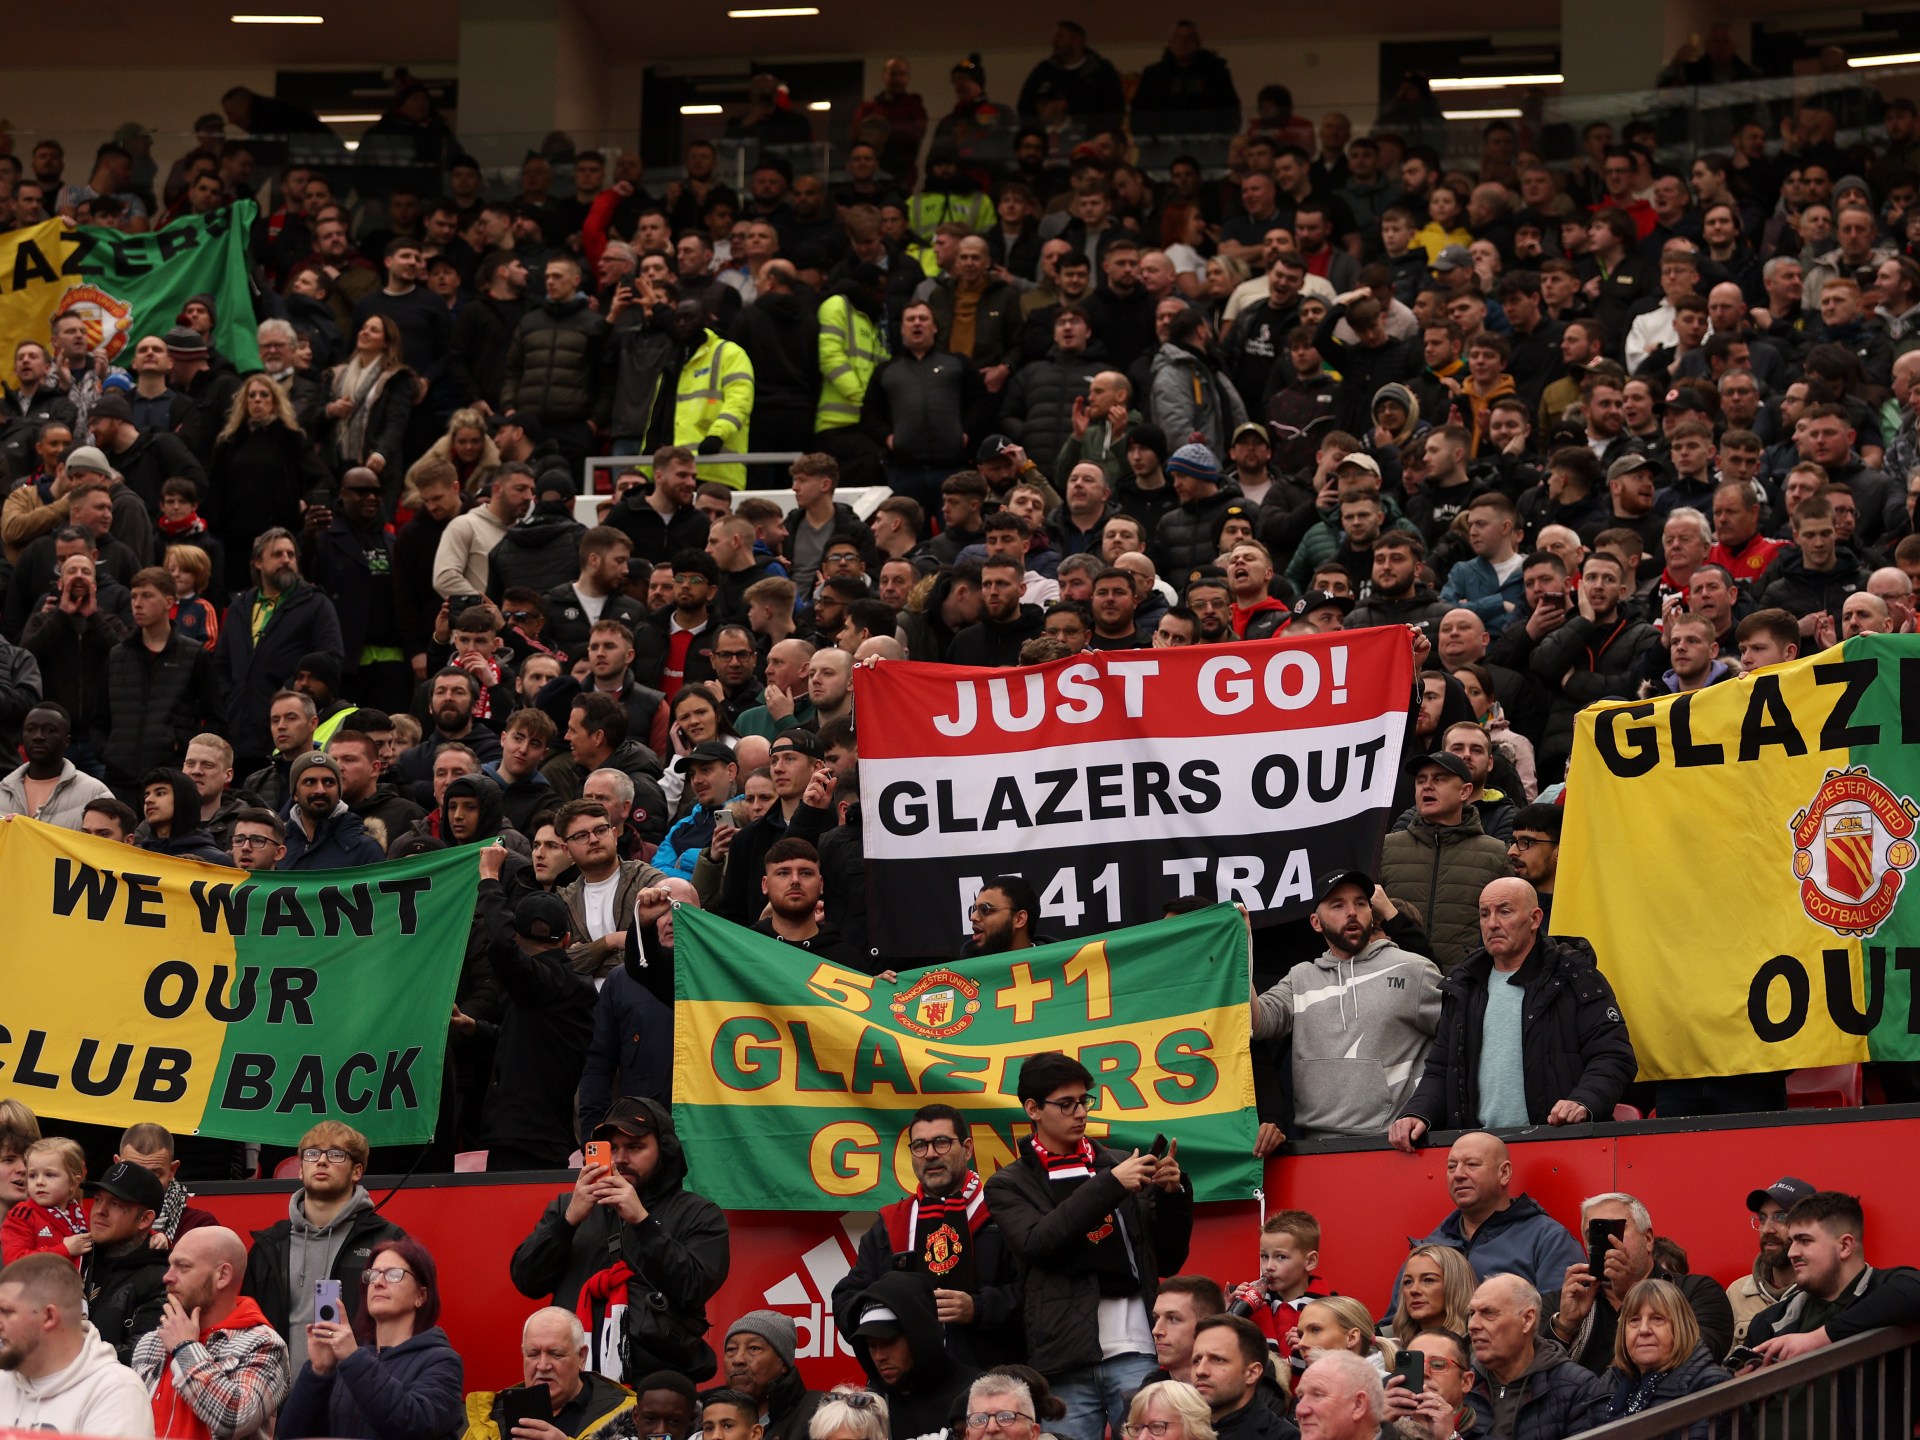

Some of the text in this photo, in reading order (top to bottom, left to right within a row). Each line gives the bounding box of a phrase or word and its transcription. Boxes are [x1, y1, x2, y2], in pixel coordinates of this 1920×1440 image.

[932, 645, 1349, 737] JUST GO!
[878, 734, 1386, 837] GLAZERS OUT
[1800, 781, 1905, 842] MANCHESTER UNITED
[52, 857, 432, 937] WE WANT
[1162, 848, 1314, 912] TRA
[1806, 884, 1893, 924] FOOTBALL CLUB
[143, 960, 319, 1026] OUR
[806, 962, 875, 1012] 5
[897, 973, 974, 1003] MANCHESTER UNITED
[1387, 976, 1406, 990] TM
[900, 1017, 967, 1036] FOOTBALL CLUB
[220, 1046, 424, 1115] BACK
